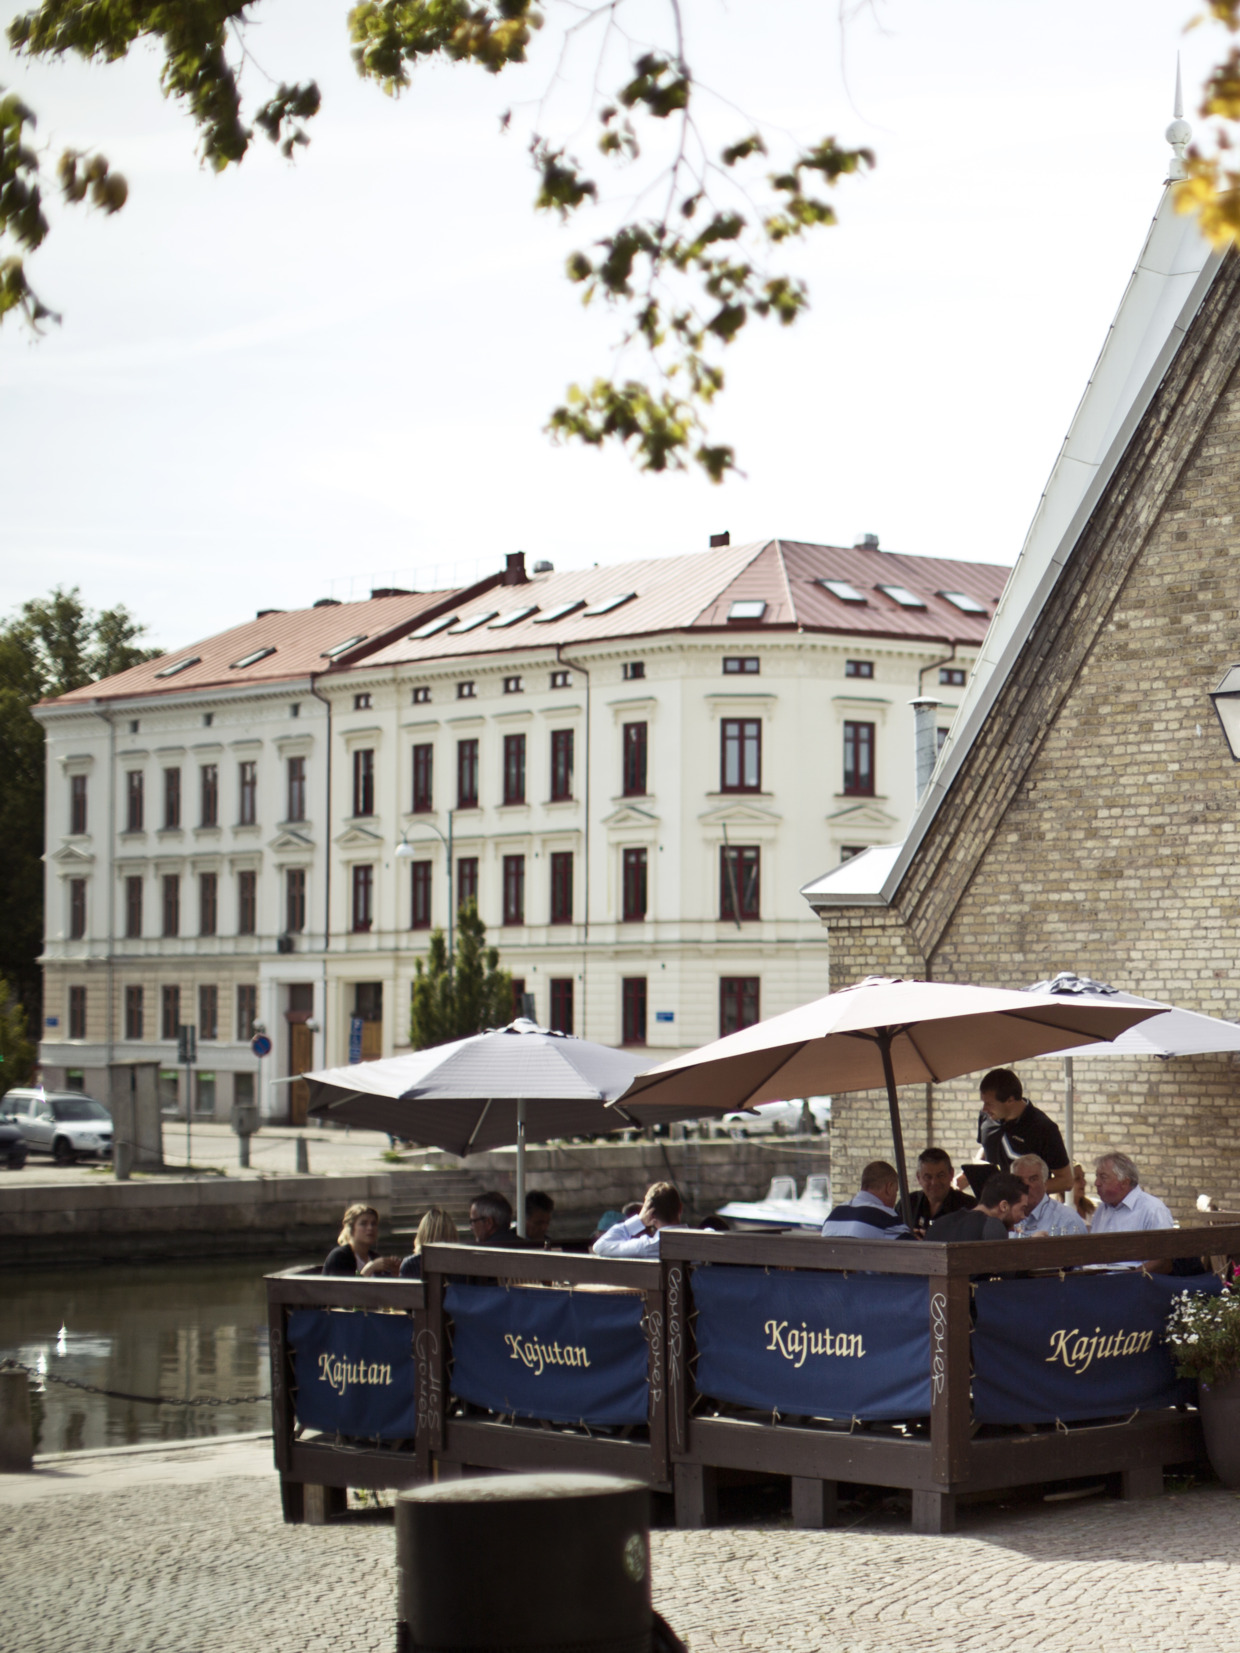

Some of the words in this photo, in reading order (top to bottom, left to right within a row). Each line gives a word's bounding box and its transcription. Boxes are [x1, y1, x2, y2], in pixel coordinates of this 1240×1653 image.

[504, 1333, 591, 1376] Kajutan
[764, 1319, 866, 1368] Kajutan
[1045, 1326, 1154, 1375] Kajutan
[318, 1353, 393, 1396] Kajutan
